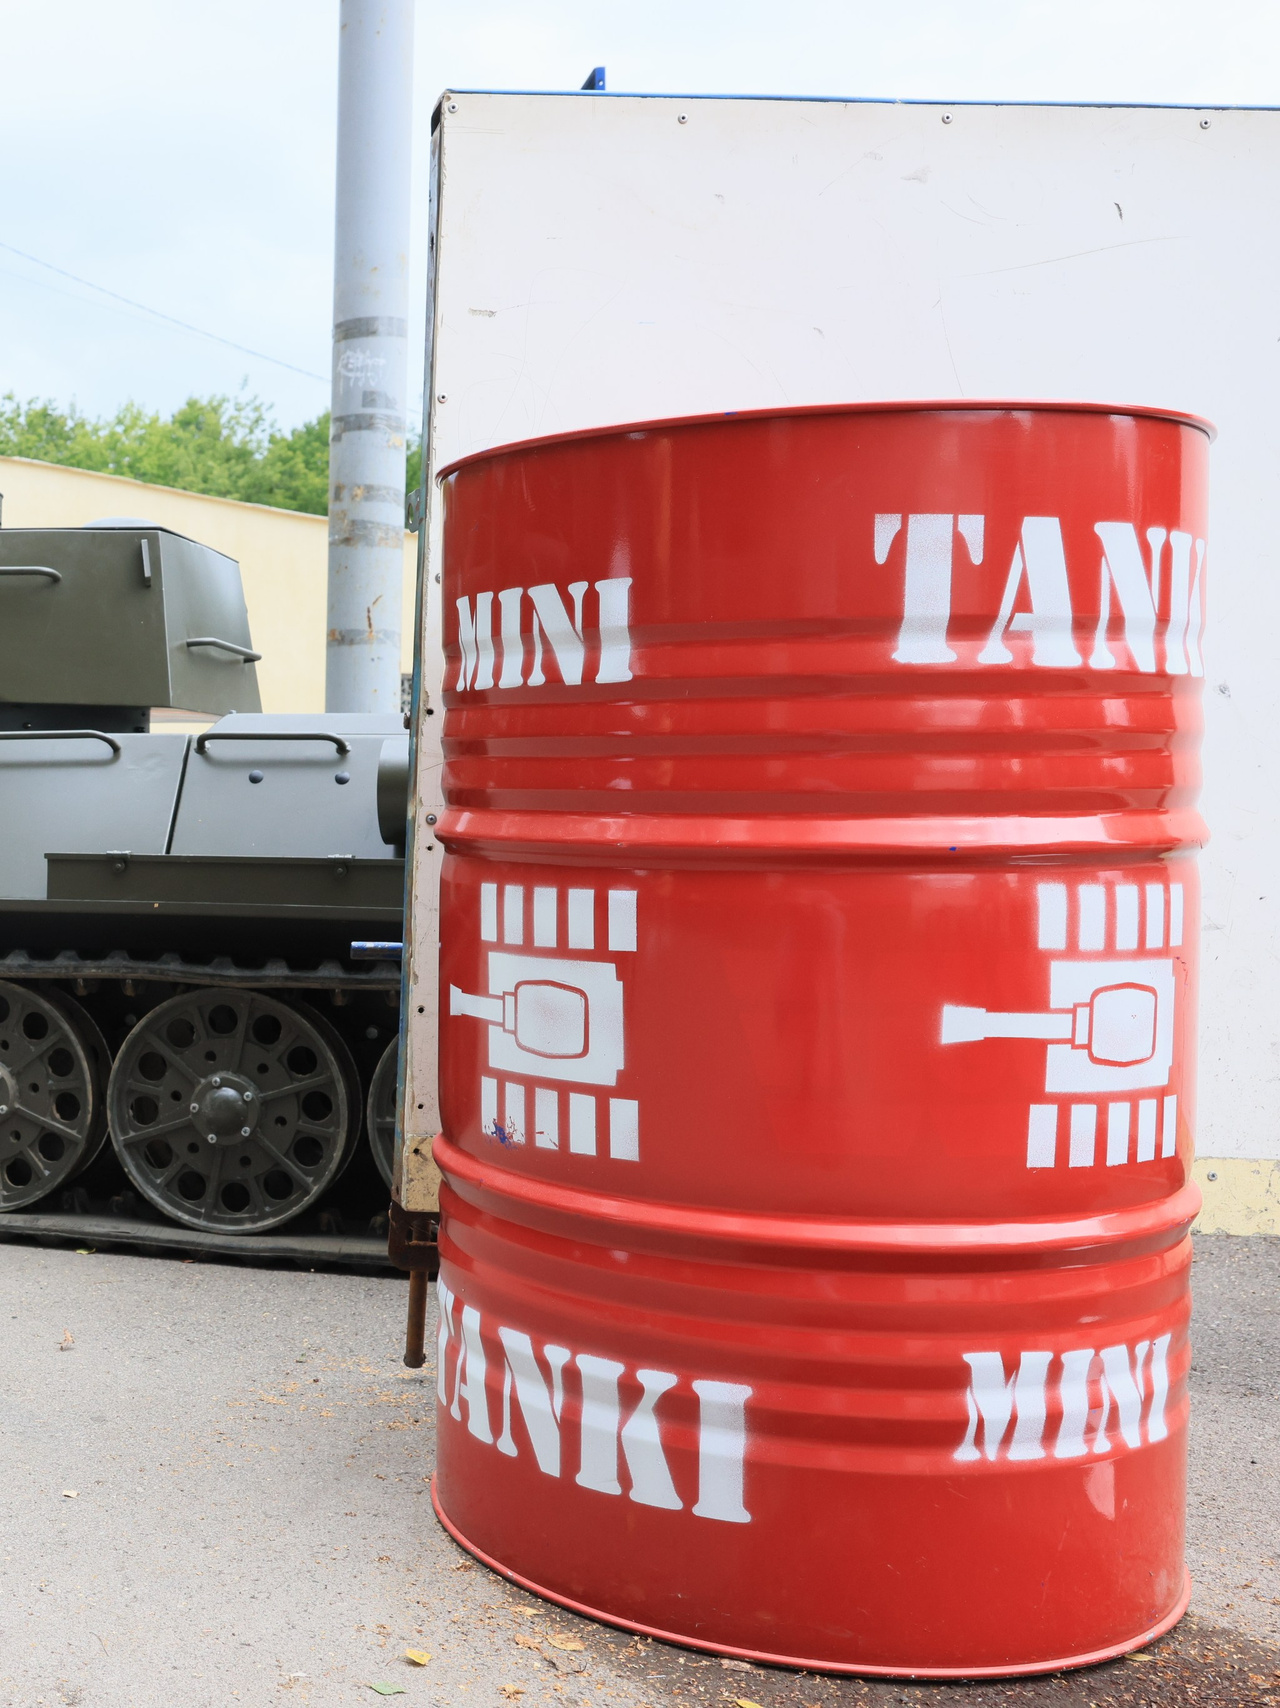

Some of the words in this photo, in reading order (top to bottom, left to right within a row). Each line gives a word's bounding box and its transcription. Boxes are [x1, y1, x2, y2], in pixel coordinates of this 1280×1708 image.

[455, 577, 634, 692] MINI
[437, 1273, 753, 1523] TANKI
[952, 1333, 1172, 1463] MINI
